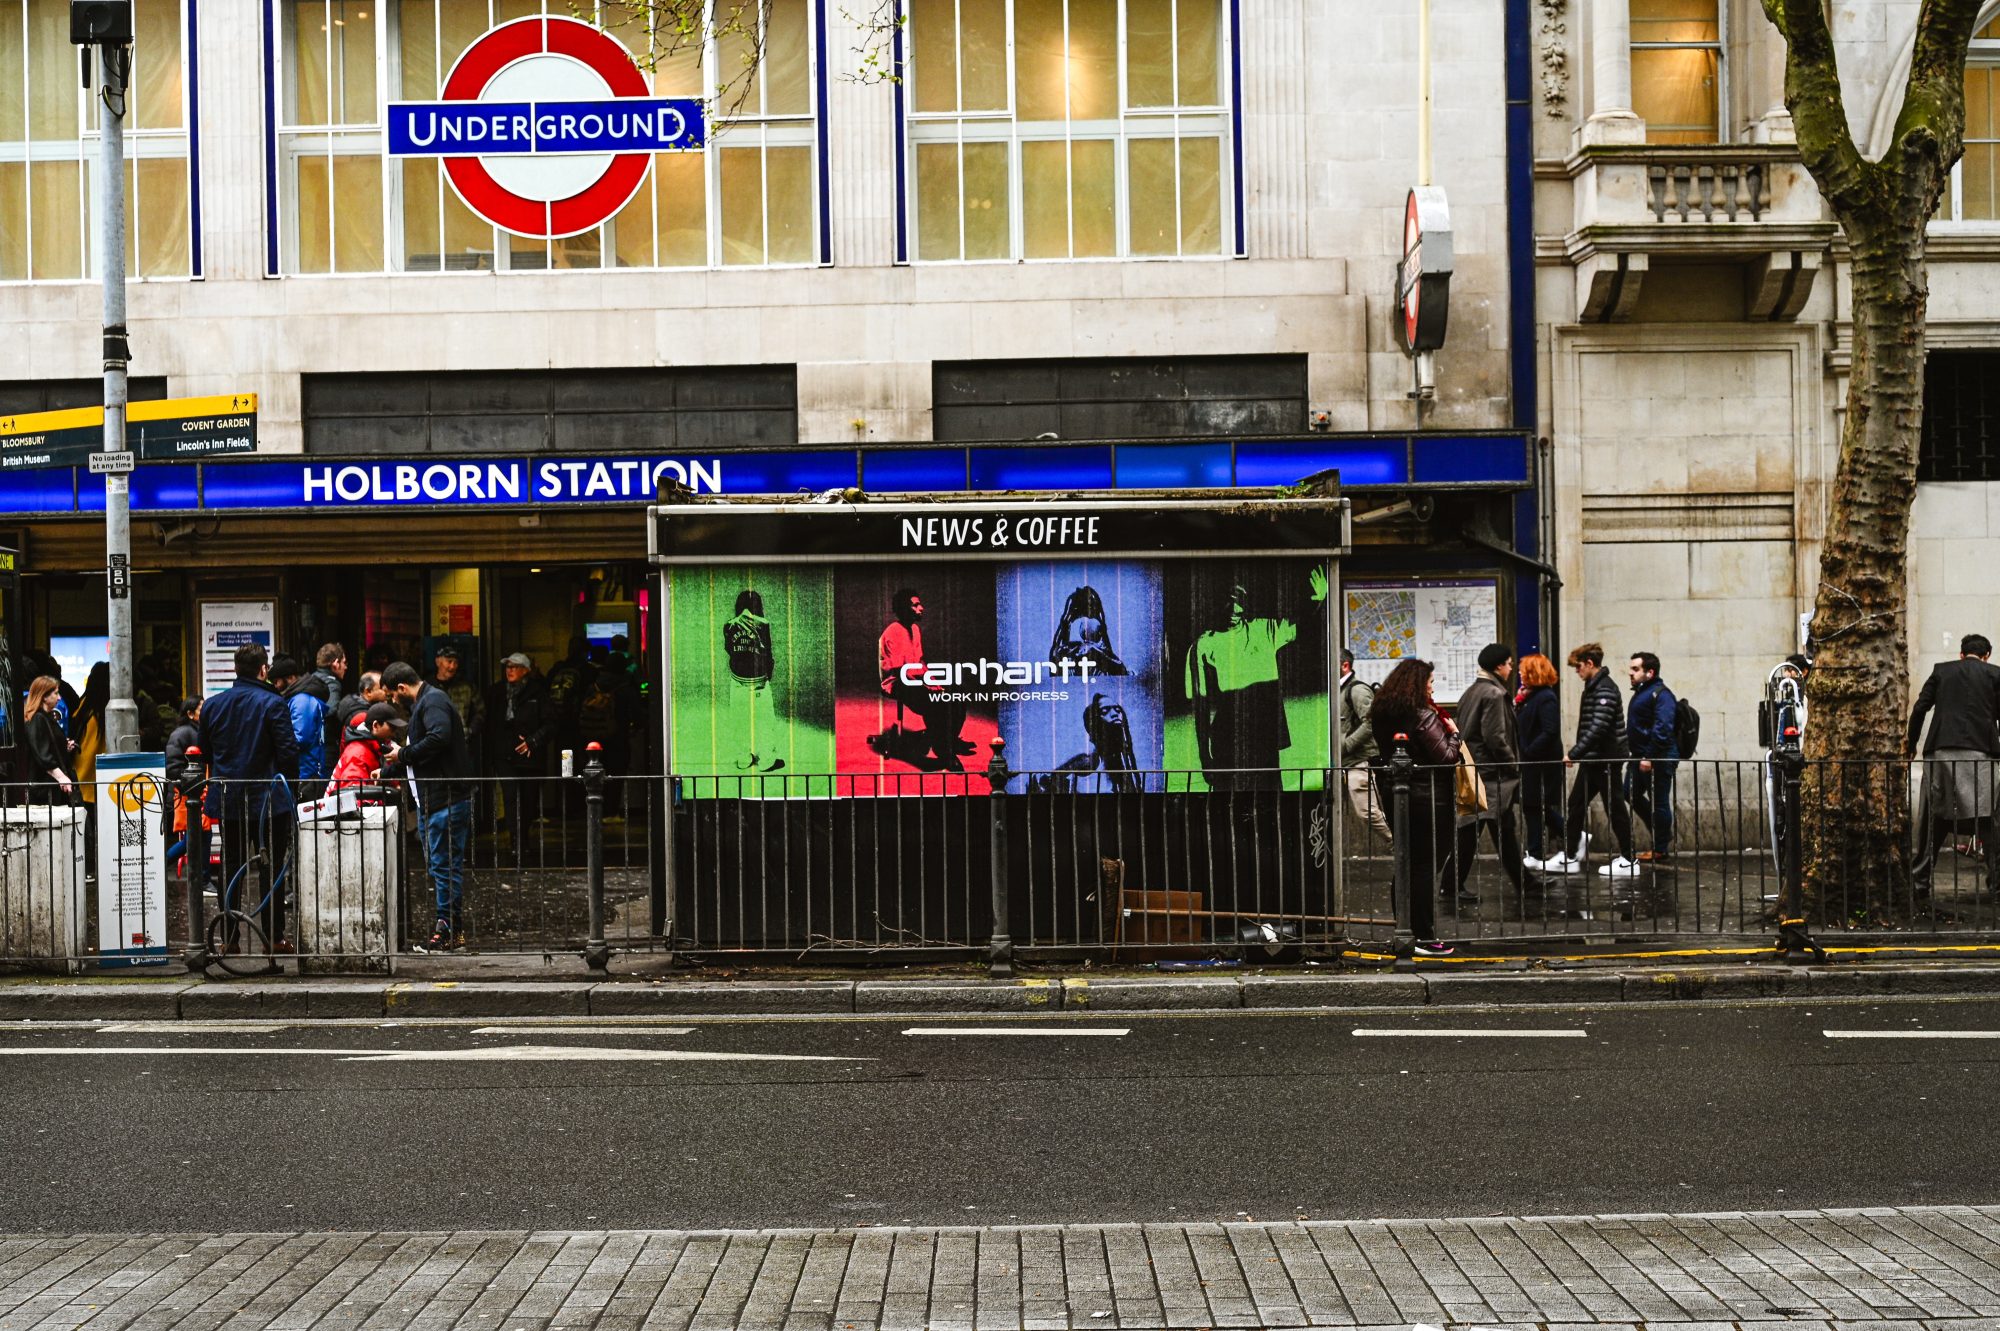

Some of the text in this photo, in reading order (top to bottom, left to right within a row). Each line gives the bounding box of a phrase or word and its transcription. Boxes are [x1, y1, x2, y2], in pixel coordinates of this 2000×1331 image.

[408, 107, 686, 147] UNDERGROUND
[181, 417, 250, 432] COVENT GARDEN
[2, 435, 46, 448] BLOOMSBURY
[176, 437, 250, 452] Lincoln's Inn Fields
[2, 454, 50, 467] British Museum
[104, 453, 131, 464] loading
[116, 462, 131, 470] time
[303, 459, 722, 502] HOLBORN STATION
[902, 516, 1100, 547] NEWS & COFFEE
[205, 619, 263, 628] Planned closures
[928, 691, 1070, 703] WORK IN PROGRESS
